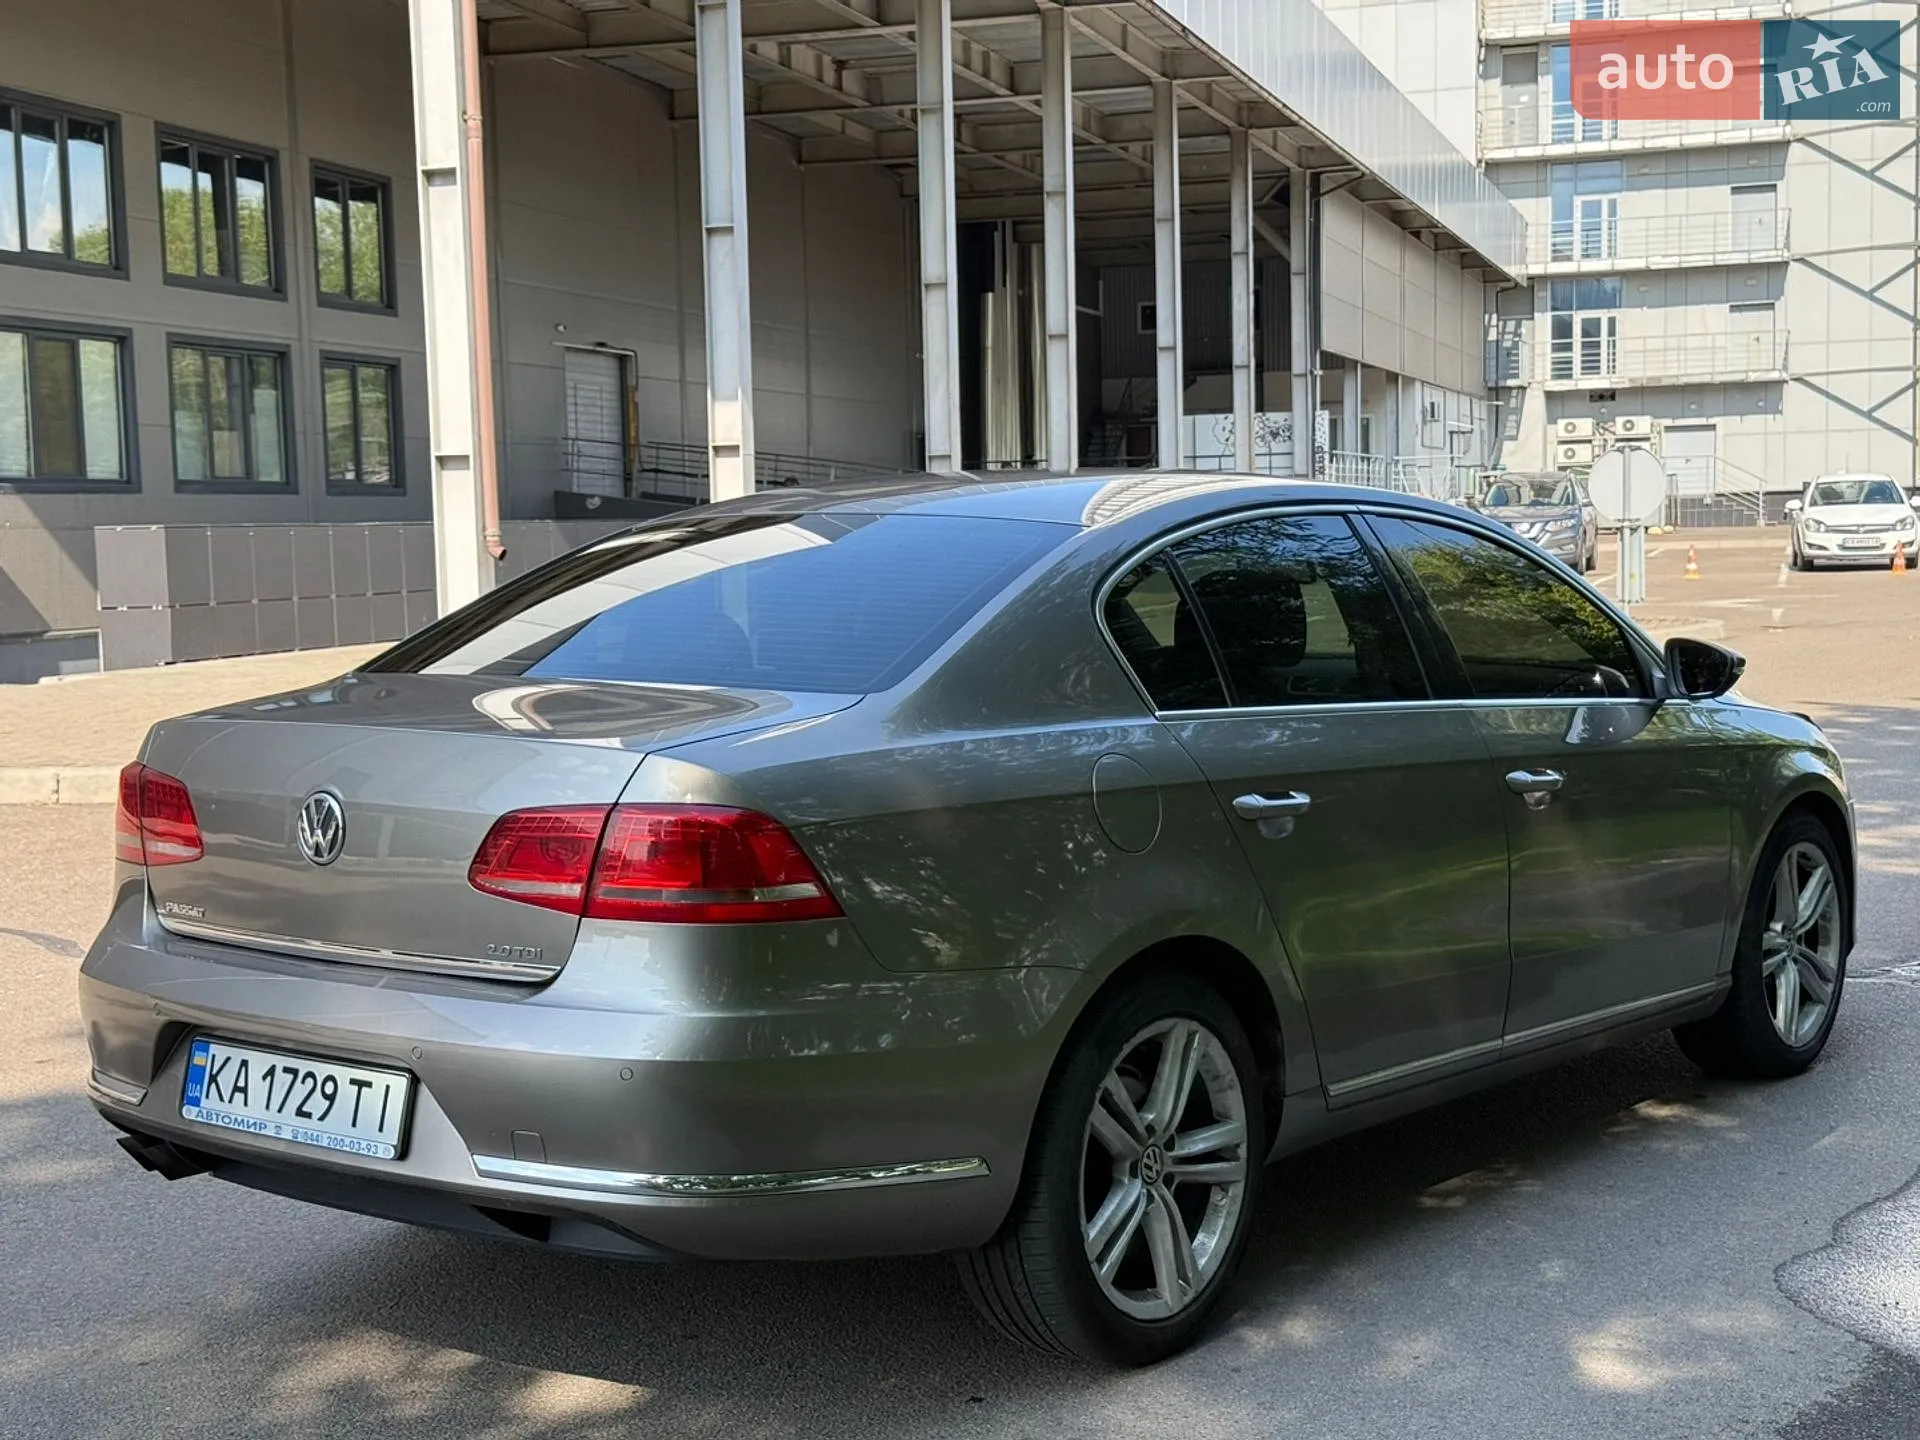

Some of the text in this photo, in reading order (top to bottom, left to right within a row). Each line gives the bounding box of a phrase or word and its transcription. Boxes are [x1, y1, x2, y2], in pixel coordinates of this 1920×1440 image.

[165, 901, 206, 919] PASSAT
[187, 1083, 200, 1097] UA
[205, 1053, 391, 1134] KA 1729 TI
[196, 1109, 268, 1131] АВТОМИР
